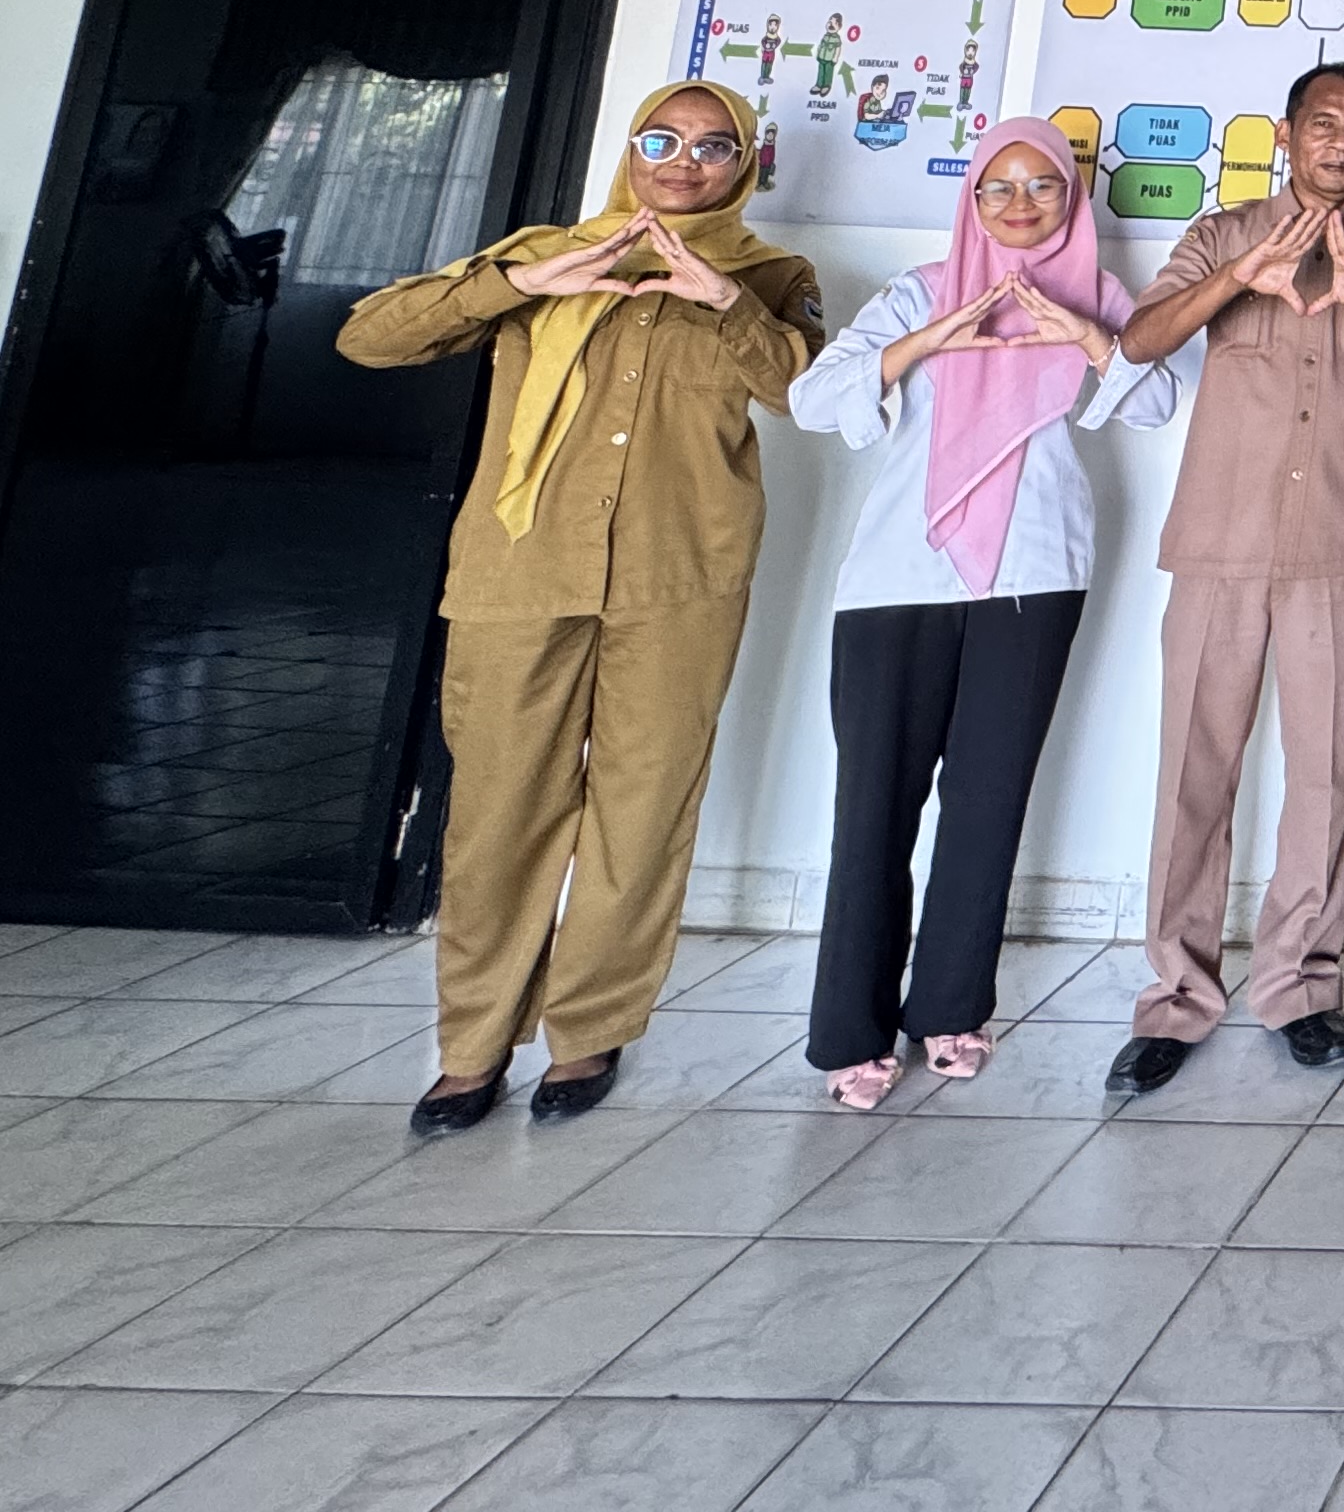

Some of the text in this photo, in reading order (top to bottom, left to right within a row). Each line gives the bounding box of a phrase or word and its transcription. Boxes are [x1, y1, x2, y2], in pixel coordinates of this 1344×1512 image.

[1164, 5, 1191, 17] PPID
[726, 23, 749, 33] PUAS
[927, 73, 950, 83] TIDAK
[806, 100, 837, 110] ATASAN
[1149, 118, 1180, 131] TIDAK
[1148, 135, 1177, 147] PUAS
[1140, 184, 1173, 198] PUAS
